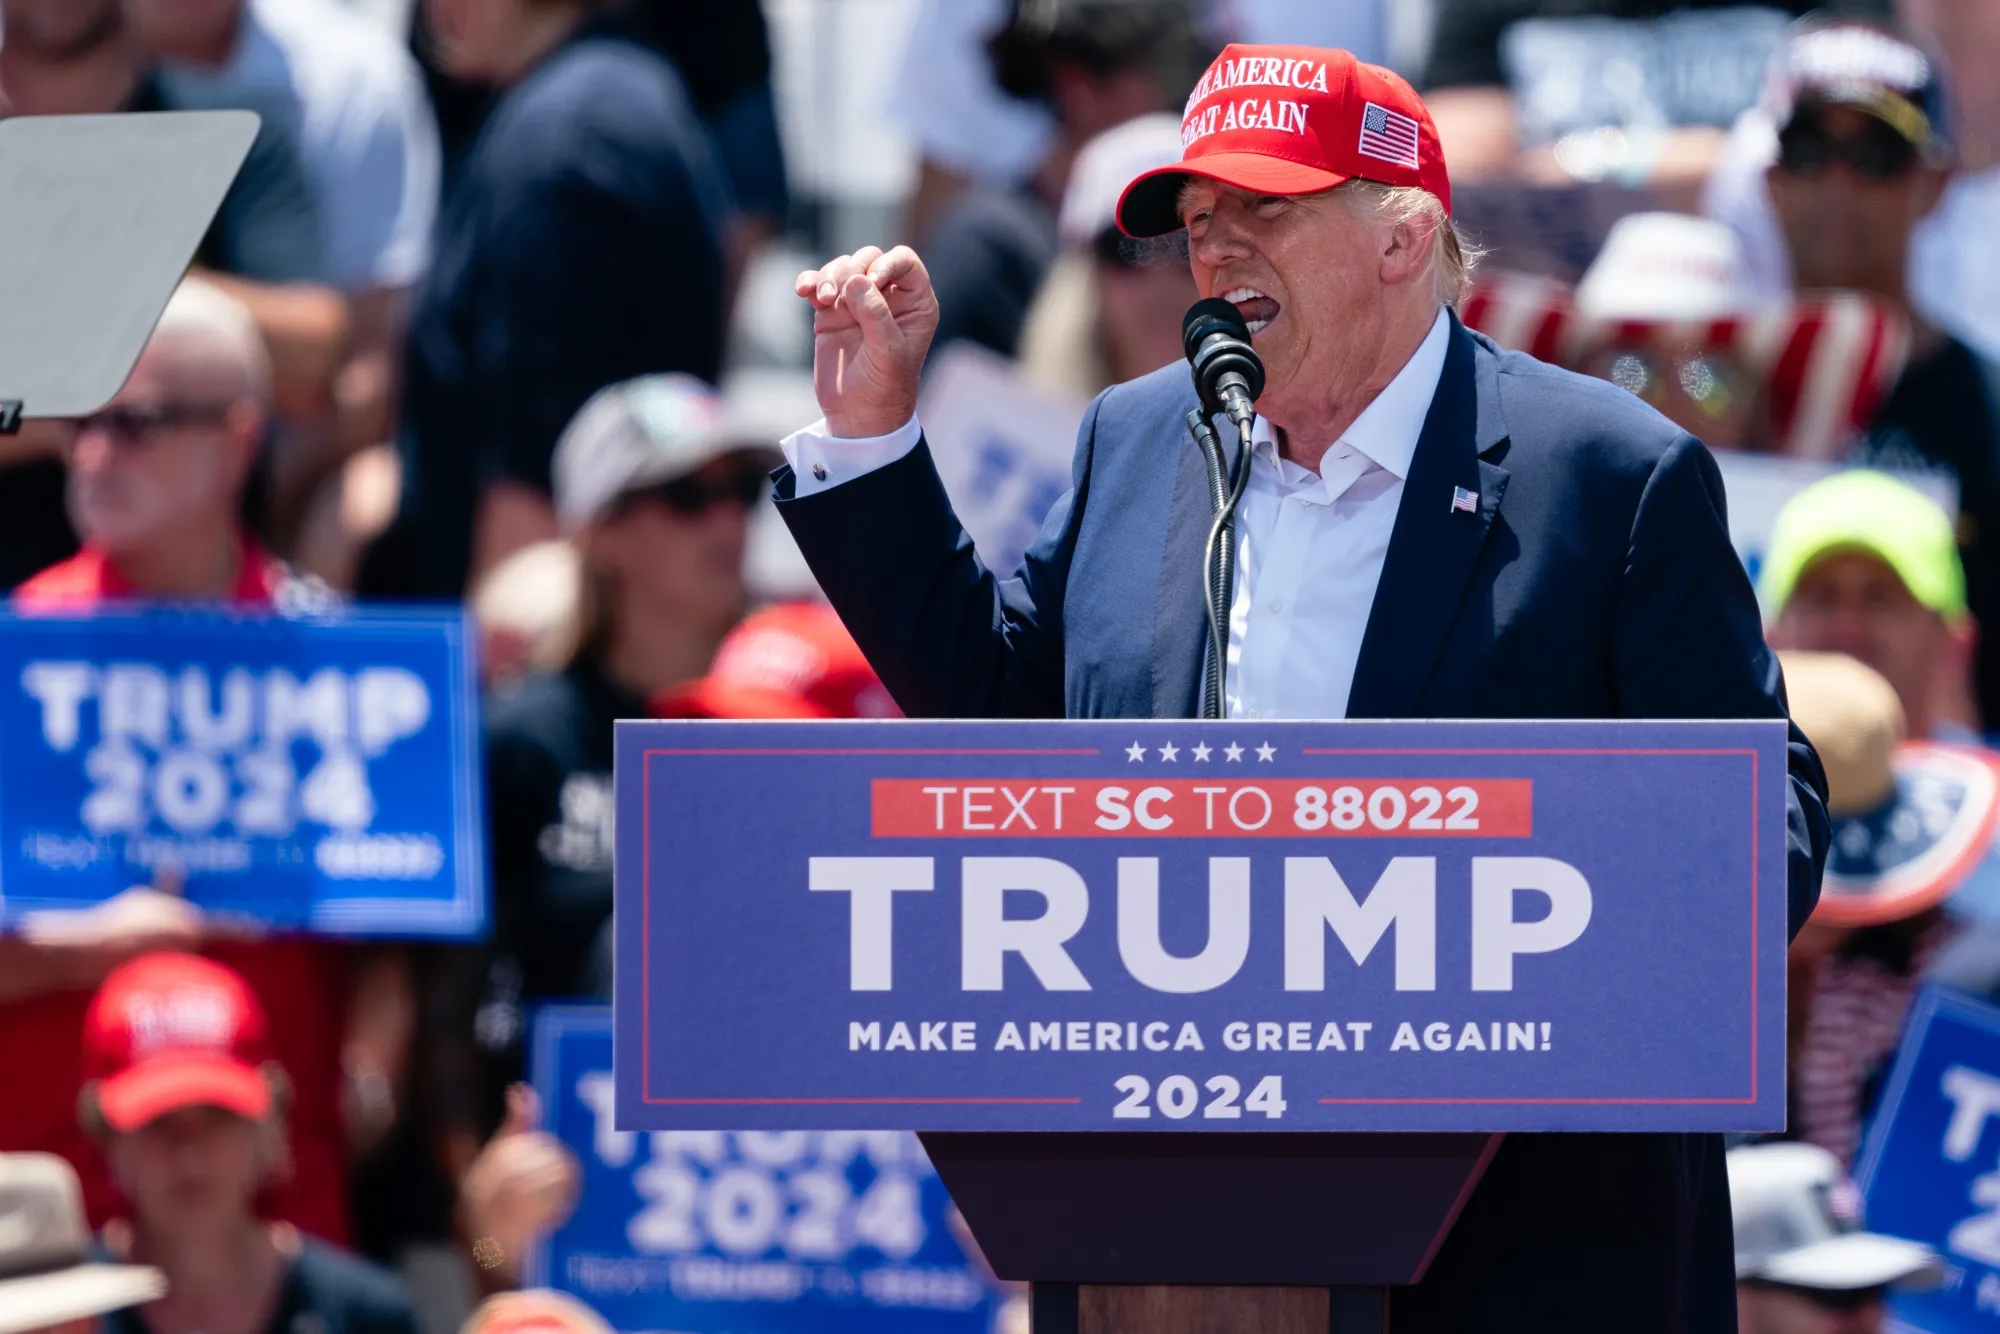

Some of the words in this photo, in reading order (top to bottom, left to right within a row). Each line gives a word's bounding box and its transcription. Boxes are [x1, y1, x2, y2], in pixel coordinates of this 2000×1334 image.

[1209, 57, 1329, 94] AMERICA
[1182, 104, 1221, 149] REAT
[1220, 99, 1310, 136] AGAIN
[22, 661, 430, 757] TRUMP
[83, 743, 374, 836] 2024
[923, 787, 1075, 830] TEXT
[1094, 787, 1174, 830] SC
[1193, 786, 1272, 830] TO
[1293, 786, 1480, 830] 88022
[808, 856, 1593, 993] TRUMP
[849, 1022, 977, 1051] MAKE
[994, 1022, 1205, 1052] AMERICA
[1222, 1022, 1373, 1052] GREAT
[1390, 1022, 1552, 1052] AGAIN!
[1113, 1074, 1287, 1119] 2024
[627, 1162, 925, 1259] 2024
